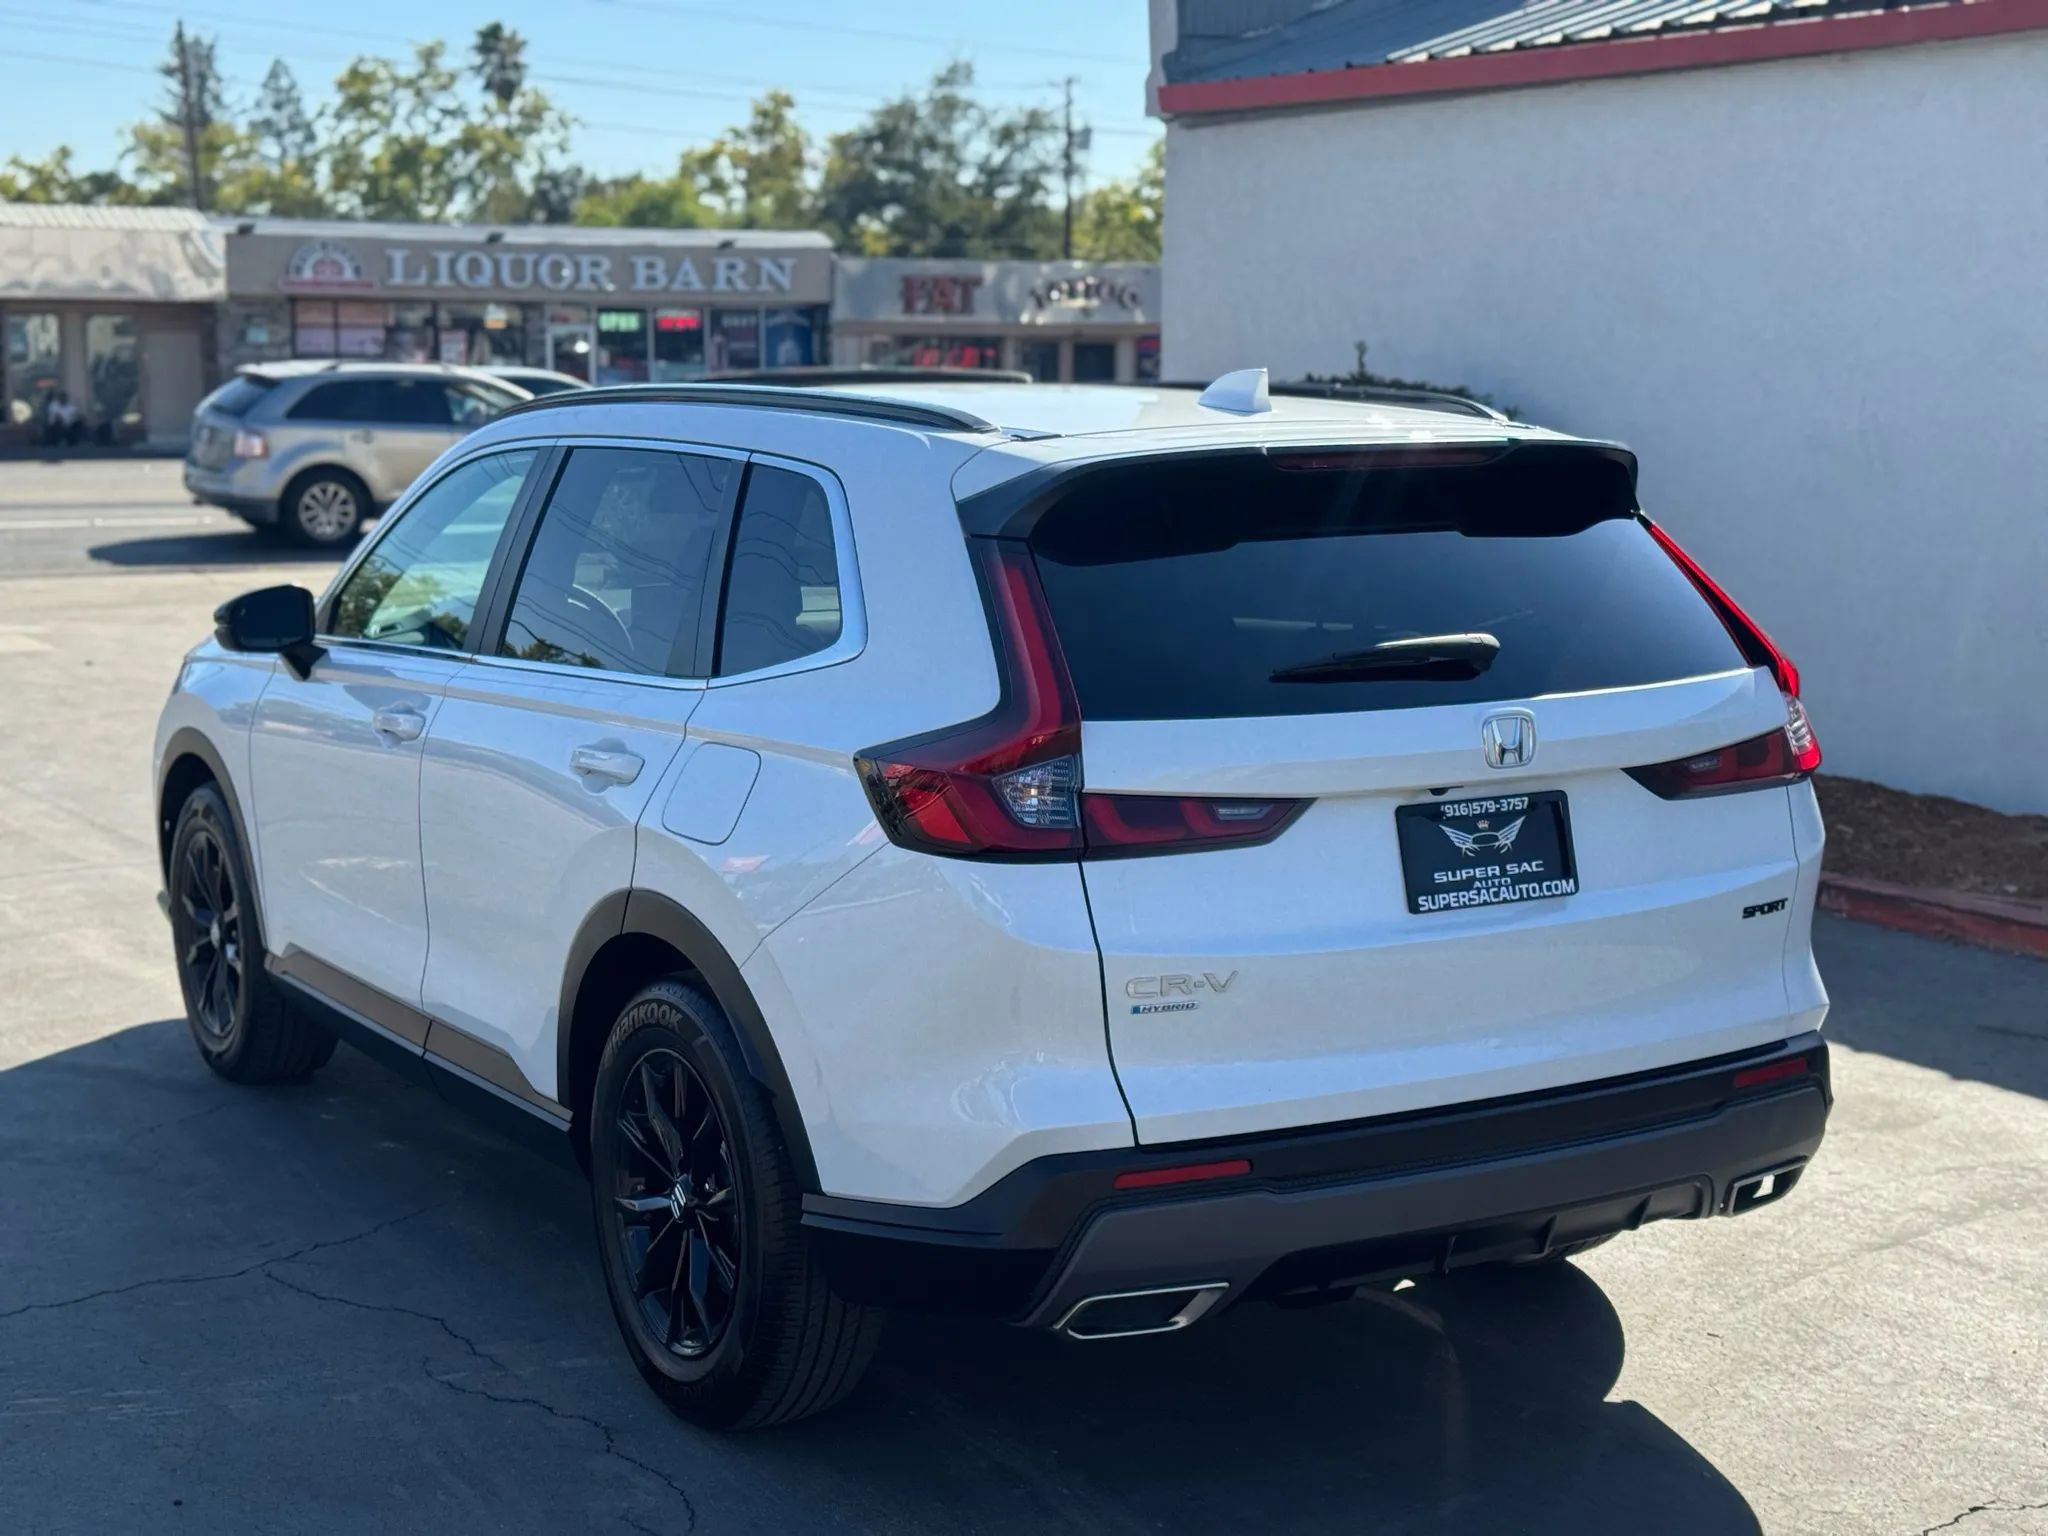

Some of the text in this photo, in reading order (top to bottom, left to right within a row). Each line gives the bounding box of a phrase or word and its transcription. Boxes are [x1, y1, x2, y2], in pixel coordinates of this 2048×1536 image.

[385, 247, 798, 292] LIQUOR BARN
[1433, 860, 1545, 883] SUPER SAC
[1472, 877, 1512, 889] AUTO
[1417, 878, 1576, 911] SUPERSACAUTO.COM
[1742, 897, 1789, 919] SPORT
[1125, 970, 1239, 999] CR-V
[1141, 1001, 1196, 1014] HYBRID
